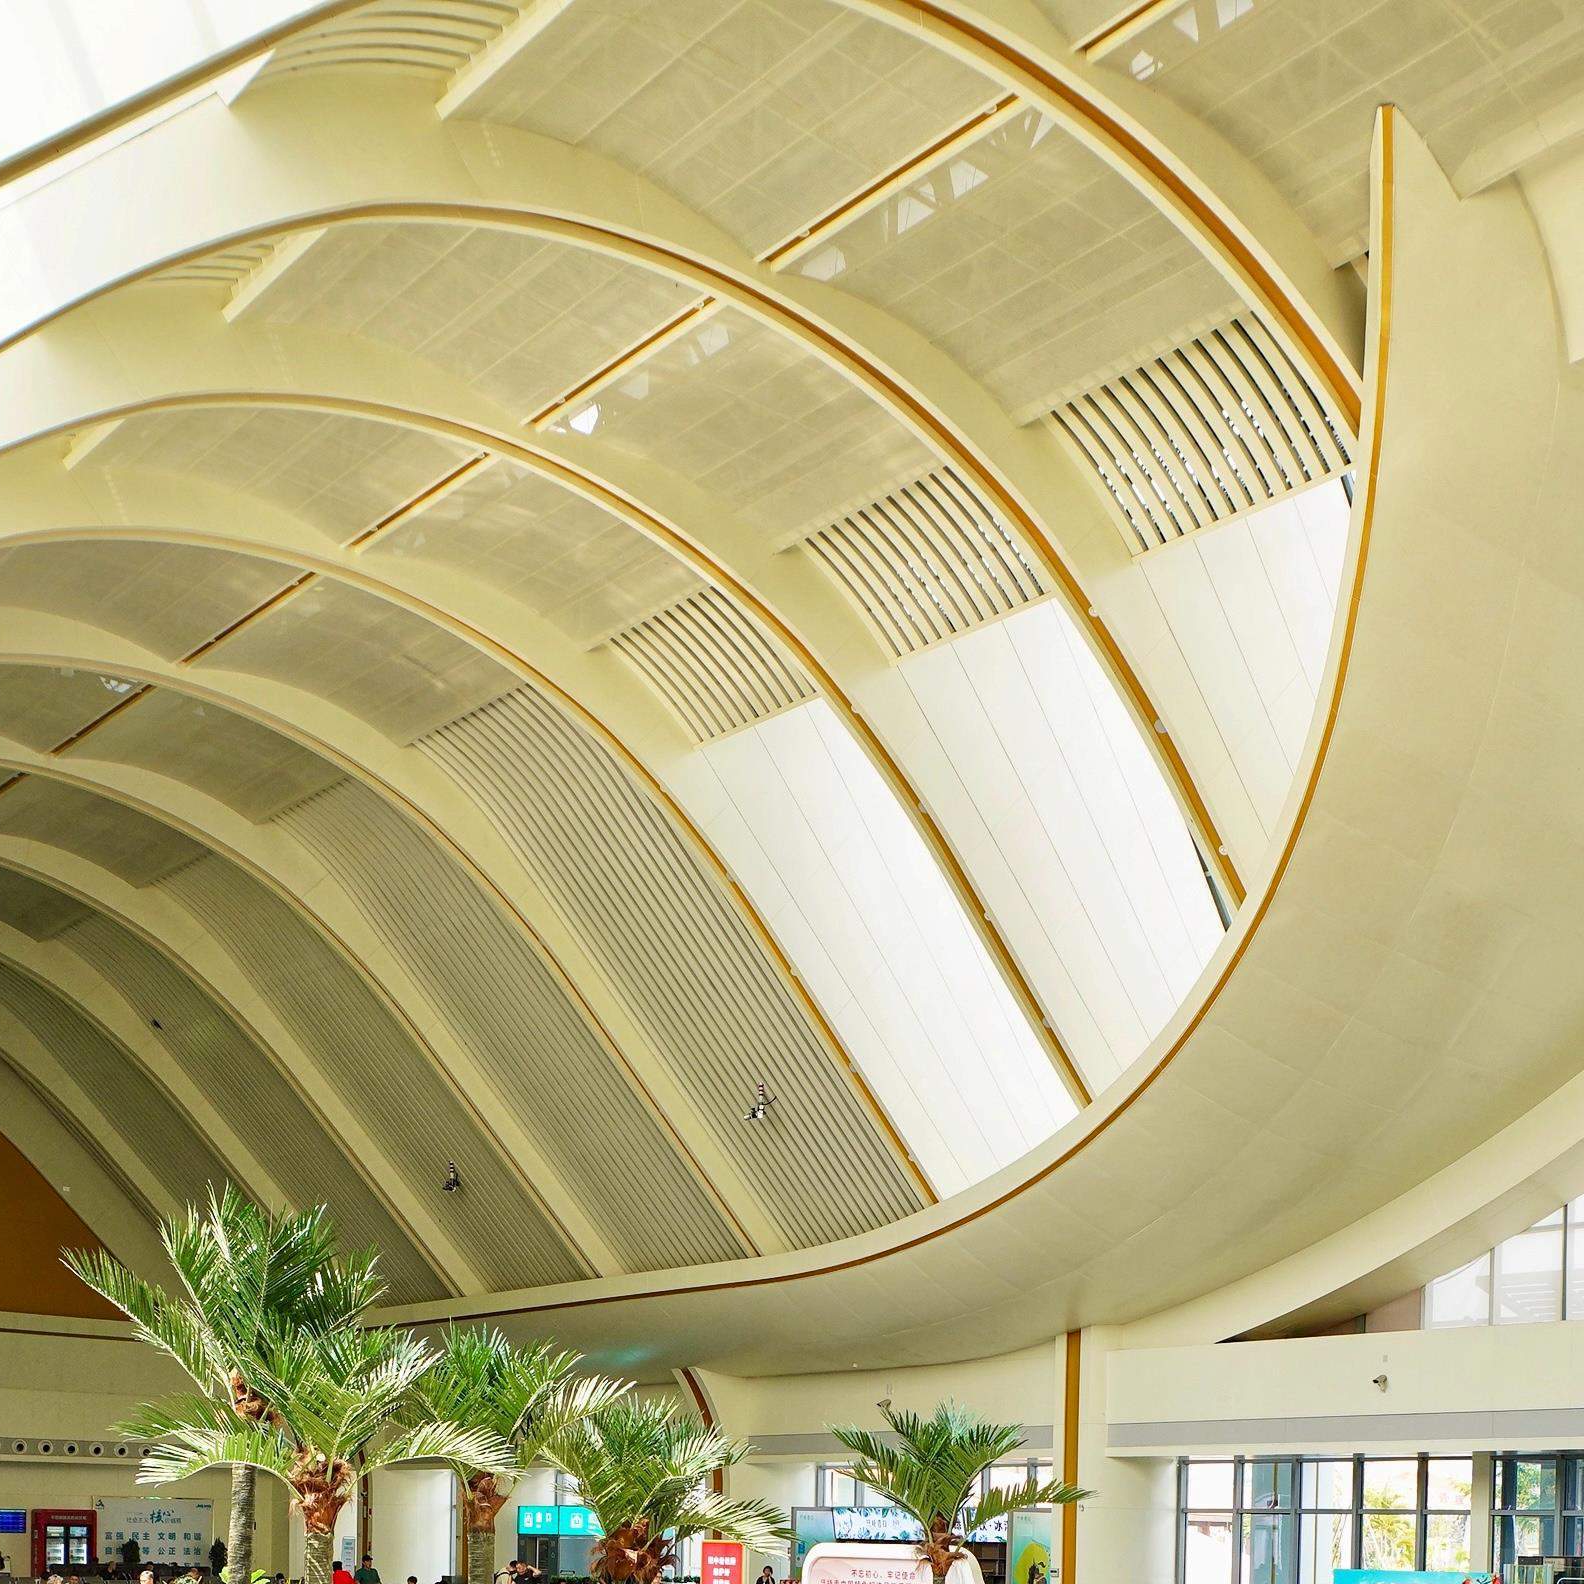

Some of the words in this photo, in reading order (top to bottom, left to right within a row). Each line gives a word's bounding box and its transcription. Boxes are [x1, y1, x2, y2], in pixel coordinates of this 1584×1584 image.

[105, 1531, 124, 1541] 富强
[131, 1531, 150, 1542] 民主
[157, 1531, 177, 1542] 文明
[183, 1531, 202, 1542] 和谐
[157, 1546, 177, 1556] 公正
[183, 1546, 202, 1556] 法治
